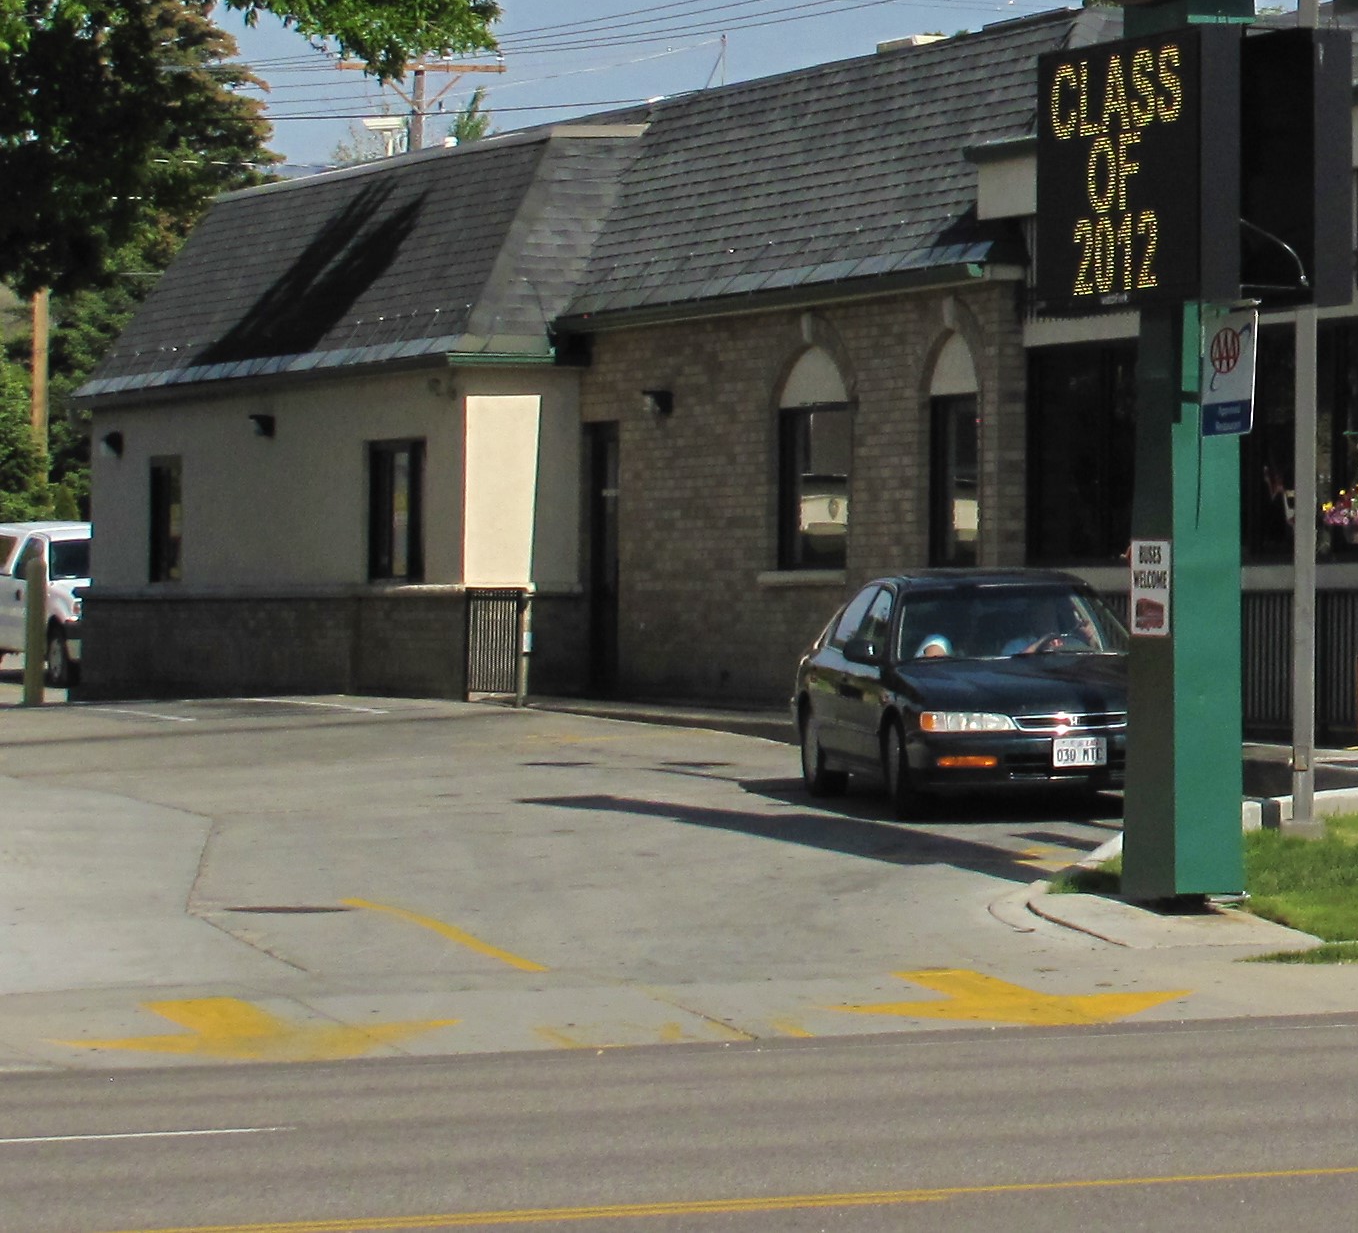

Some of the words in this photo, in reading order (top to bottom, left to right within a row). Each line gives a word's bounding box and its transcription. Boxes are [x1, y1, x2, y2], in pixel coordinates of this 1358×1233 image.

[1050, 44, 1182, 141] CLASS
[1087, 130, 1142, 214] OF
[1073, 210, 1158, 296] 2012
[1211, 327, 1240, 373] AAA
[1133, 570, 1168, 589] WELCOME
[1139, 545, 1162, 564] BUSES
